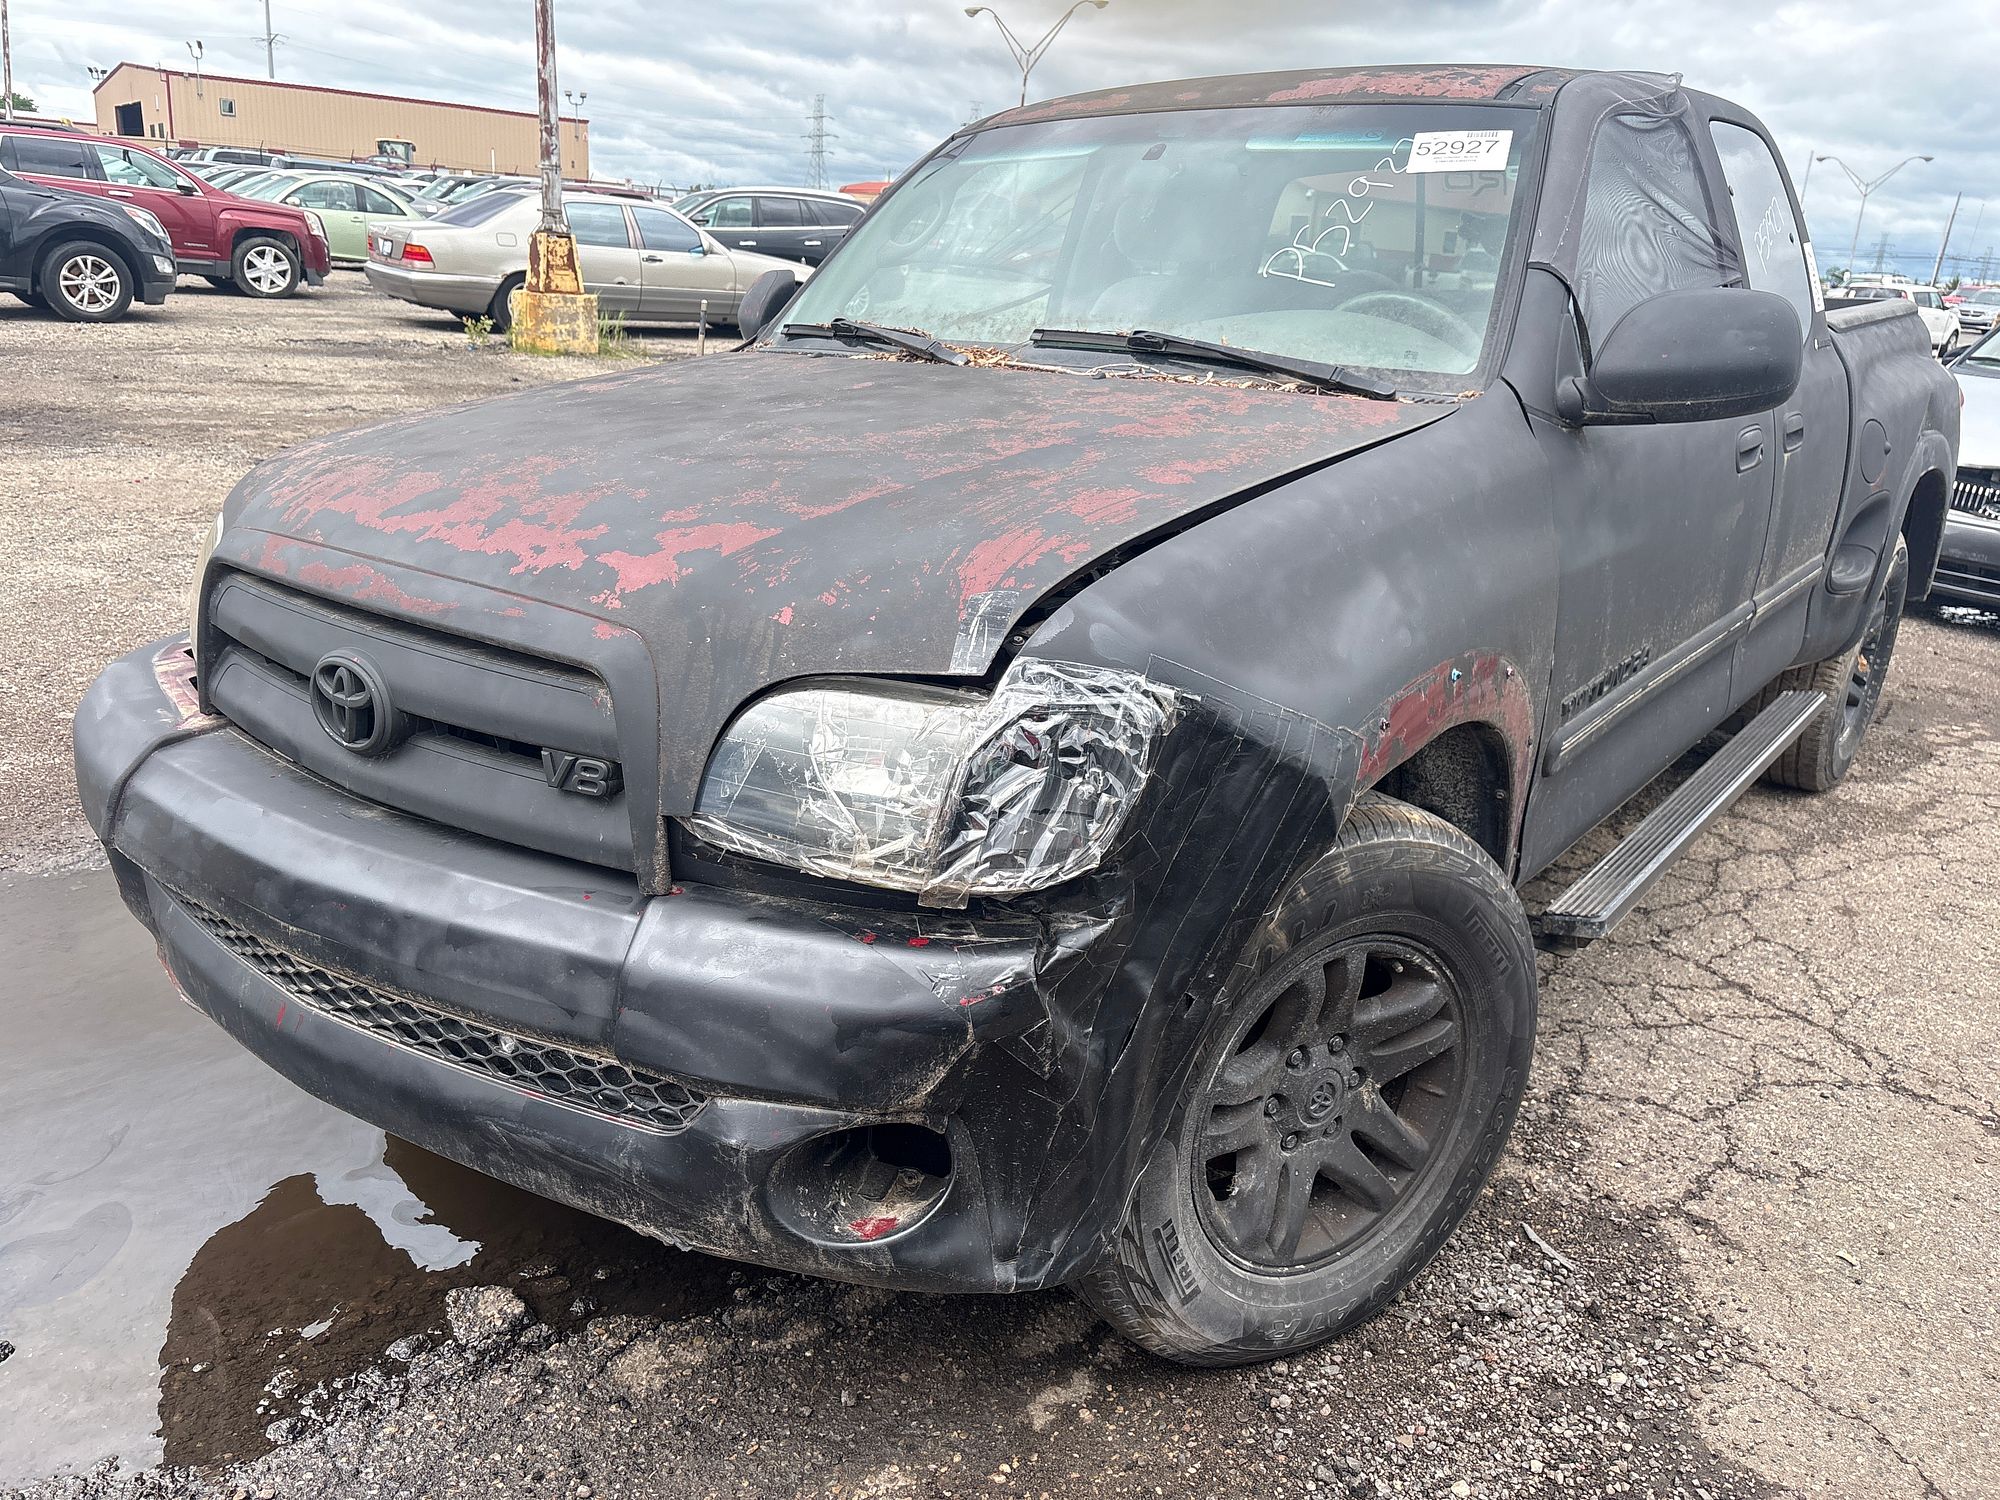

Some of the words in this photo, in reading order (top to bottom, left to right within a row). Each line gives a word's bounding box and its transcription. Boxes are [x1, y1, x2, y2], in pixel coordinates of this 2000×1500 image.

[1416, 140, 1500, 156] 52927
[541, 749, 609, 796] V8
[1151, 1217, 1202, 1306] PIRELLI
